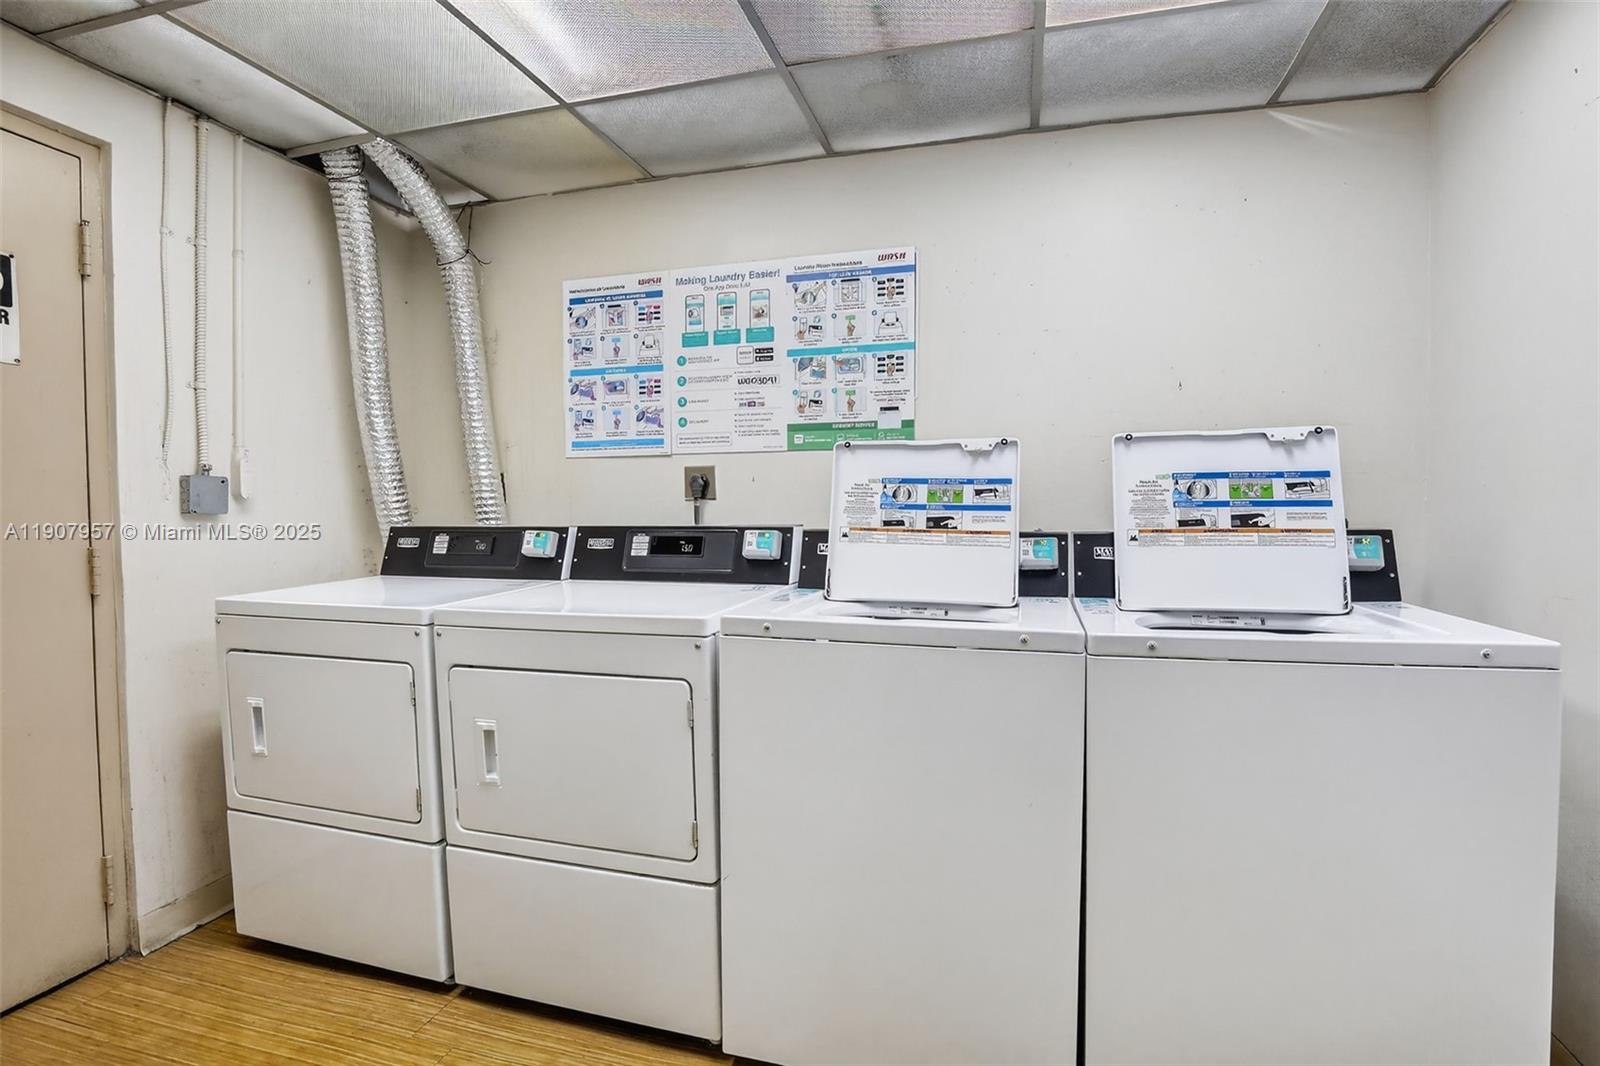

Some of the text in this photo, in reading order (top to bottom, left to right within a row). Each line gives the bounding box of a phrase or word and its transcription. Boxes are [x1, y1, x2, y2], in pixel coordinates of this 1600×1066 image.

[675, 269, 780, 286] Making Laundry Easier!
